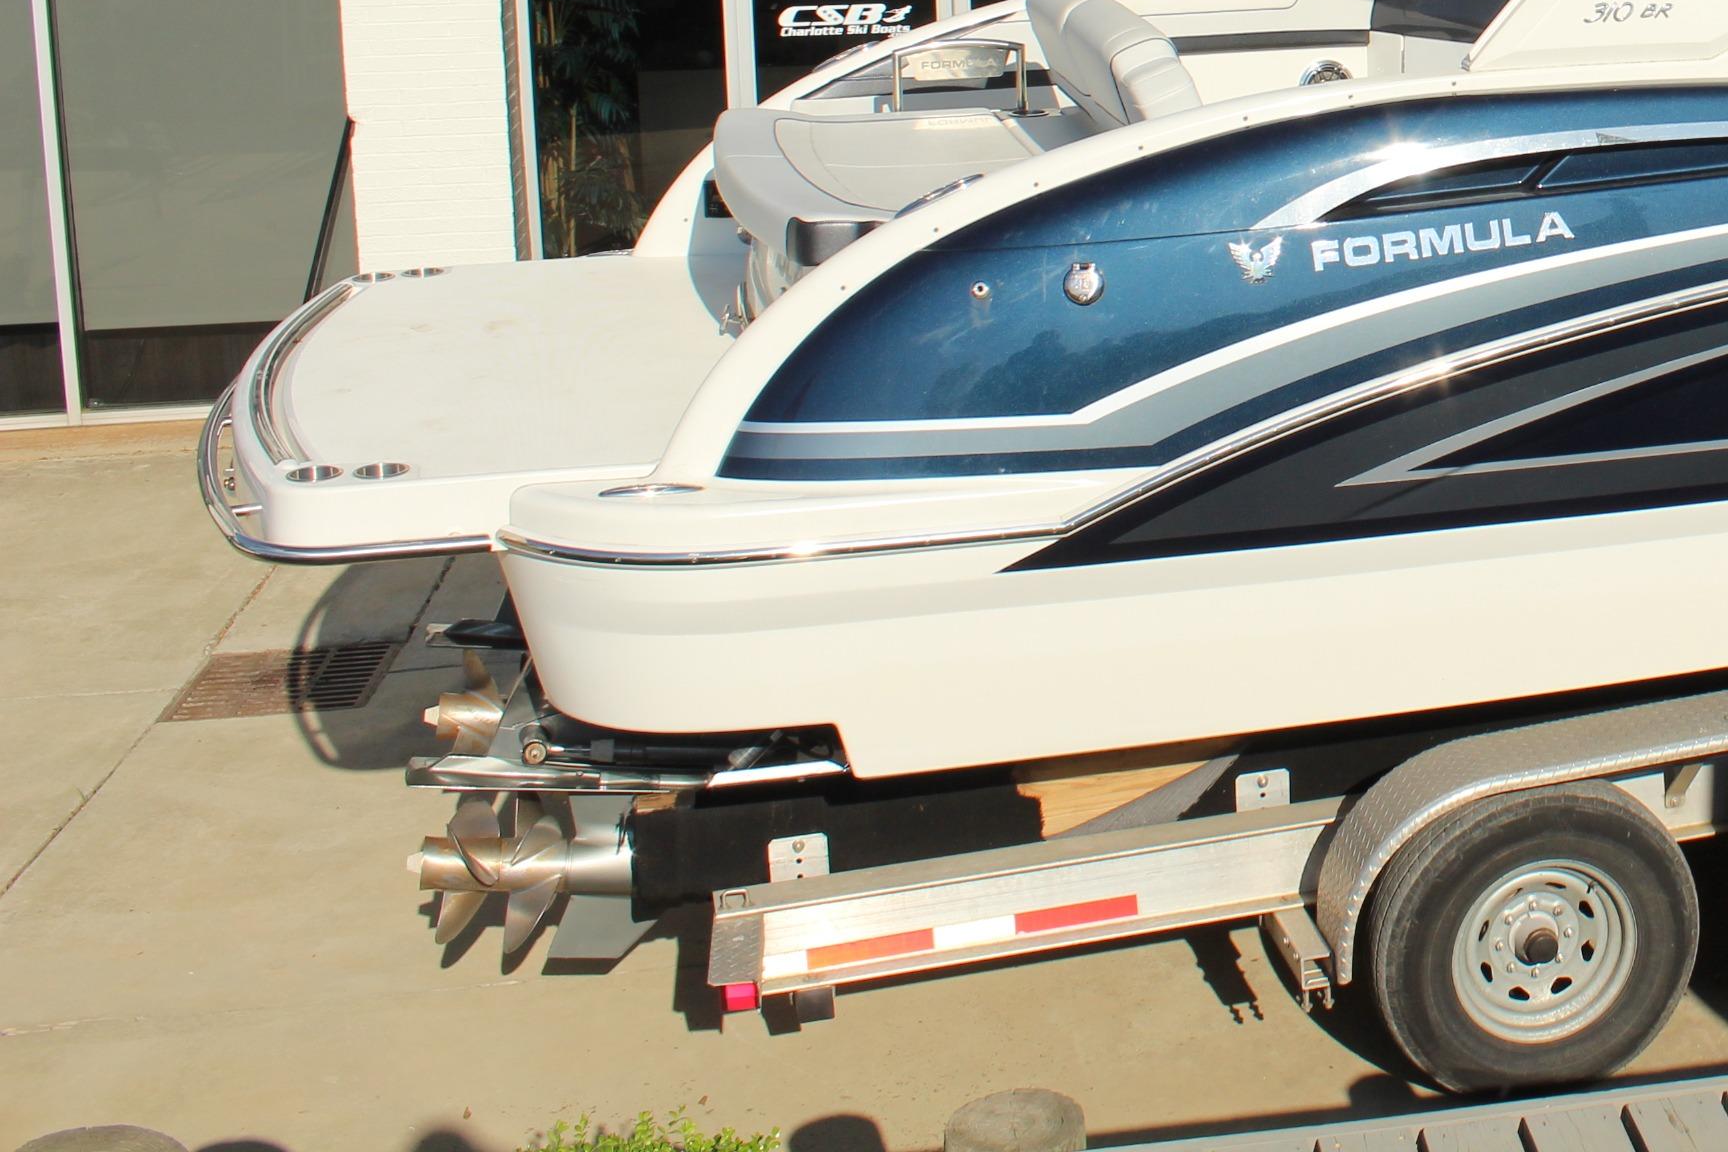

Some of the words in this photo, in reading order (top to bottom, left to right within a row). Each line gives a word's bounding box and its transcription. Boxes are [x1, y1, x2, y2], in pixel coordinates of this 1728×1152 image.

[778, 3, 886, 27] CSB
[1583, 1, 1634, 23] 310
[780, 26, 843, 37] Charlotte
[846, 25, 868, 35] Ski
[871, 24, 911, 34] Boats
[1311, 211, 1575, 272] FORMULA
